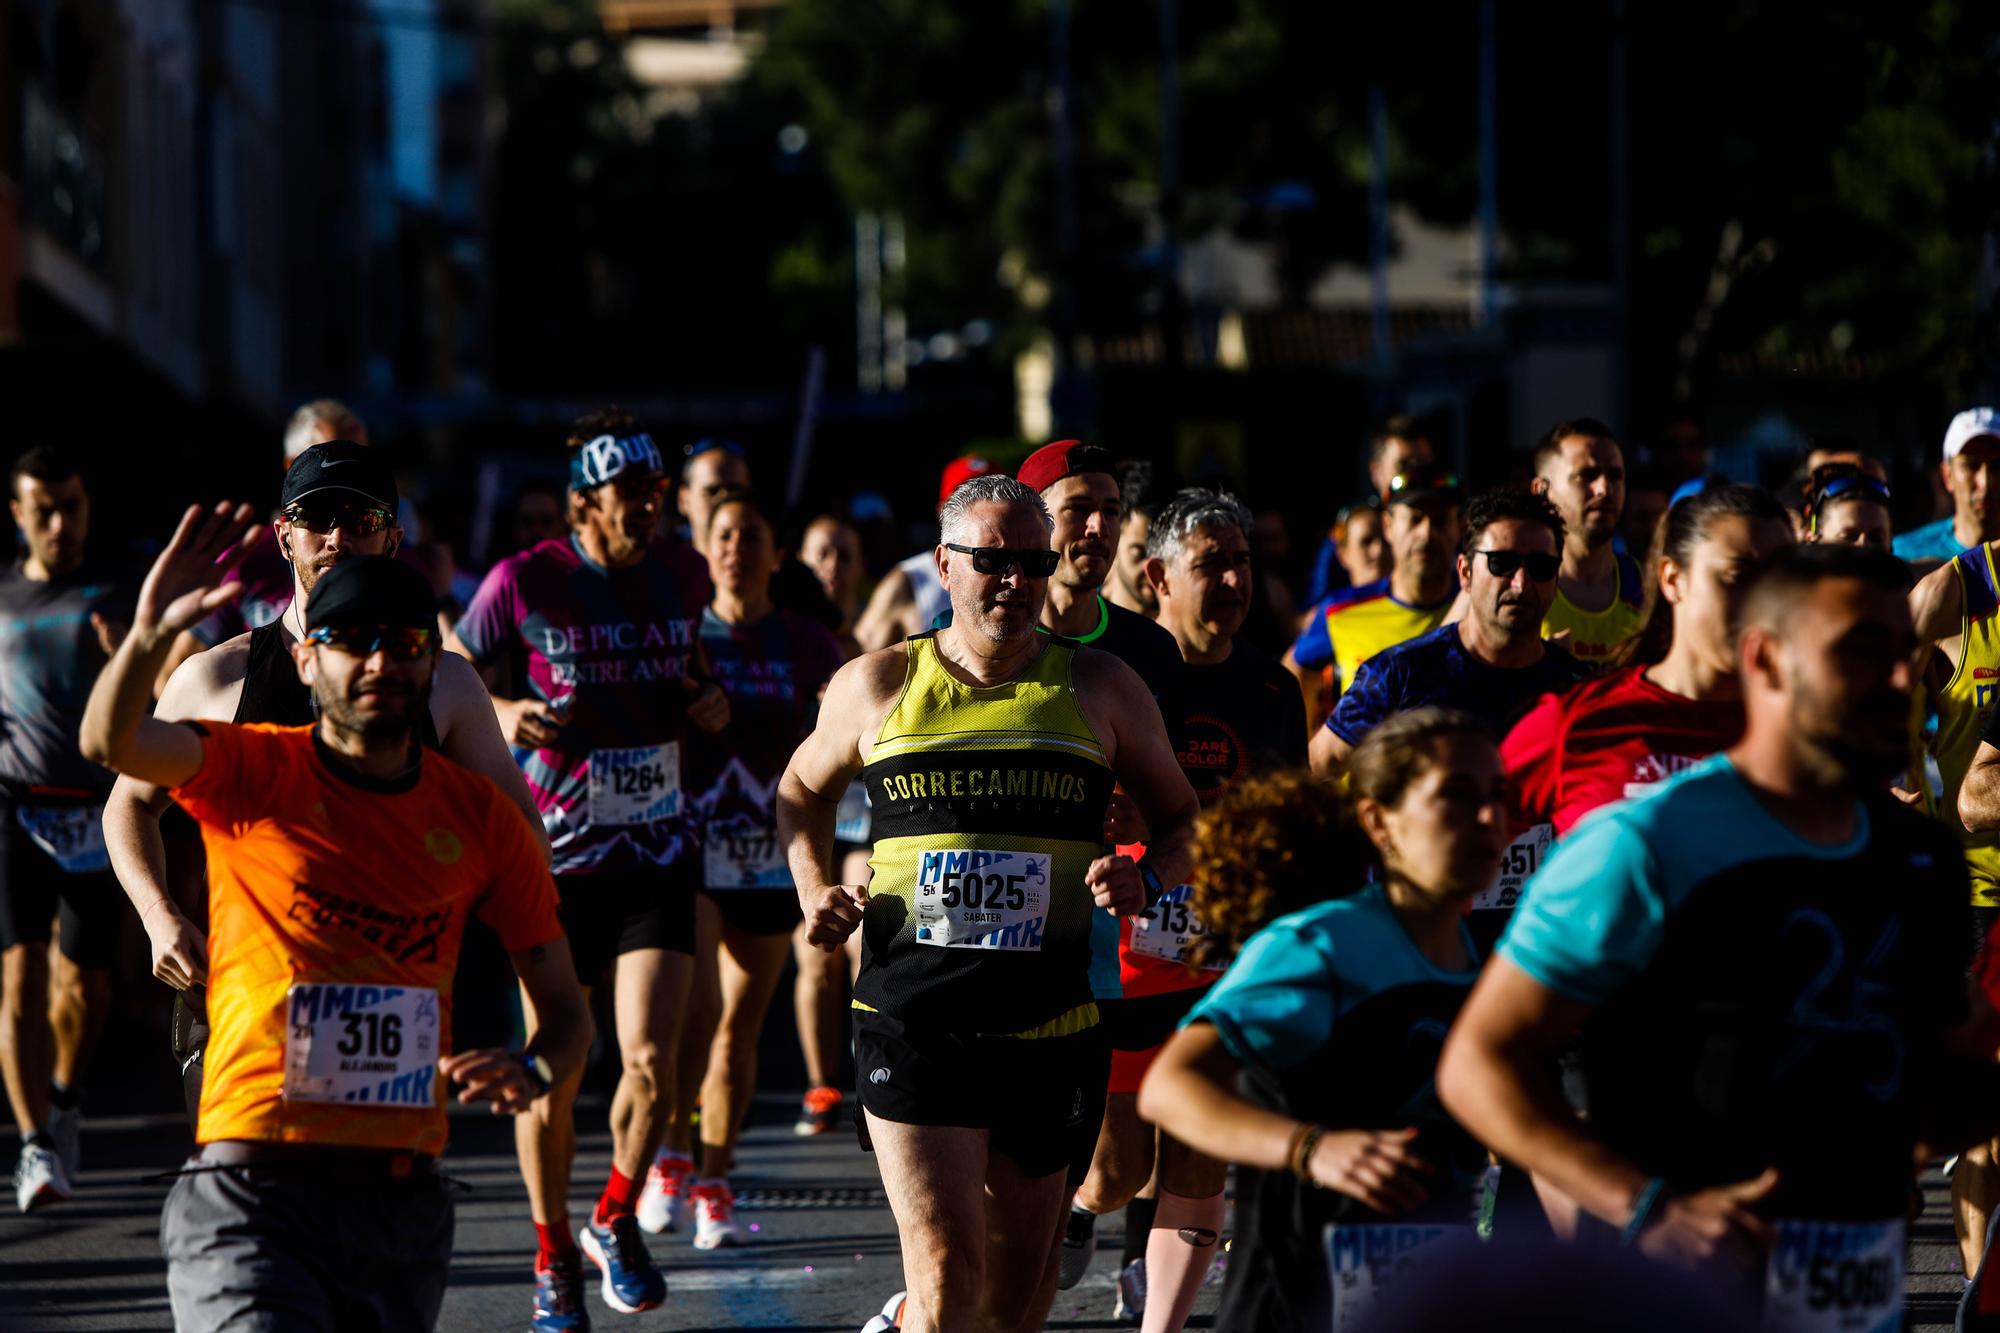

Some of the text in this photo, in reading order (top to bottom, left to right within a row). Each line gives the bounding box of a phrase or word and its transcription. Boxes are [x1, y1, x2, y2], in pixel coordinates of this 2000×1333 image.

[544, 626, 586, 656] DE
[590, 622, 639, 652] PIC
[642, 620, 666, 649] A
[1177, 751, 1228, 766] COLOR
[612, 763, 664, 795] 1264
[882, 768, 1090, 803] CORRECAMINOS
[941, 872, 1026, 911] 5025
[963, 911, 1002, 924] SABATER
[338, 1012, 402, 1057] 316
